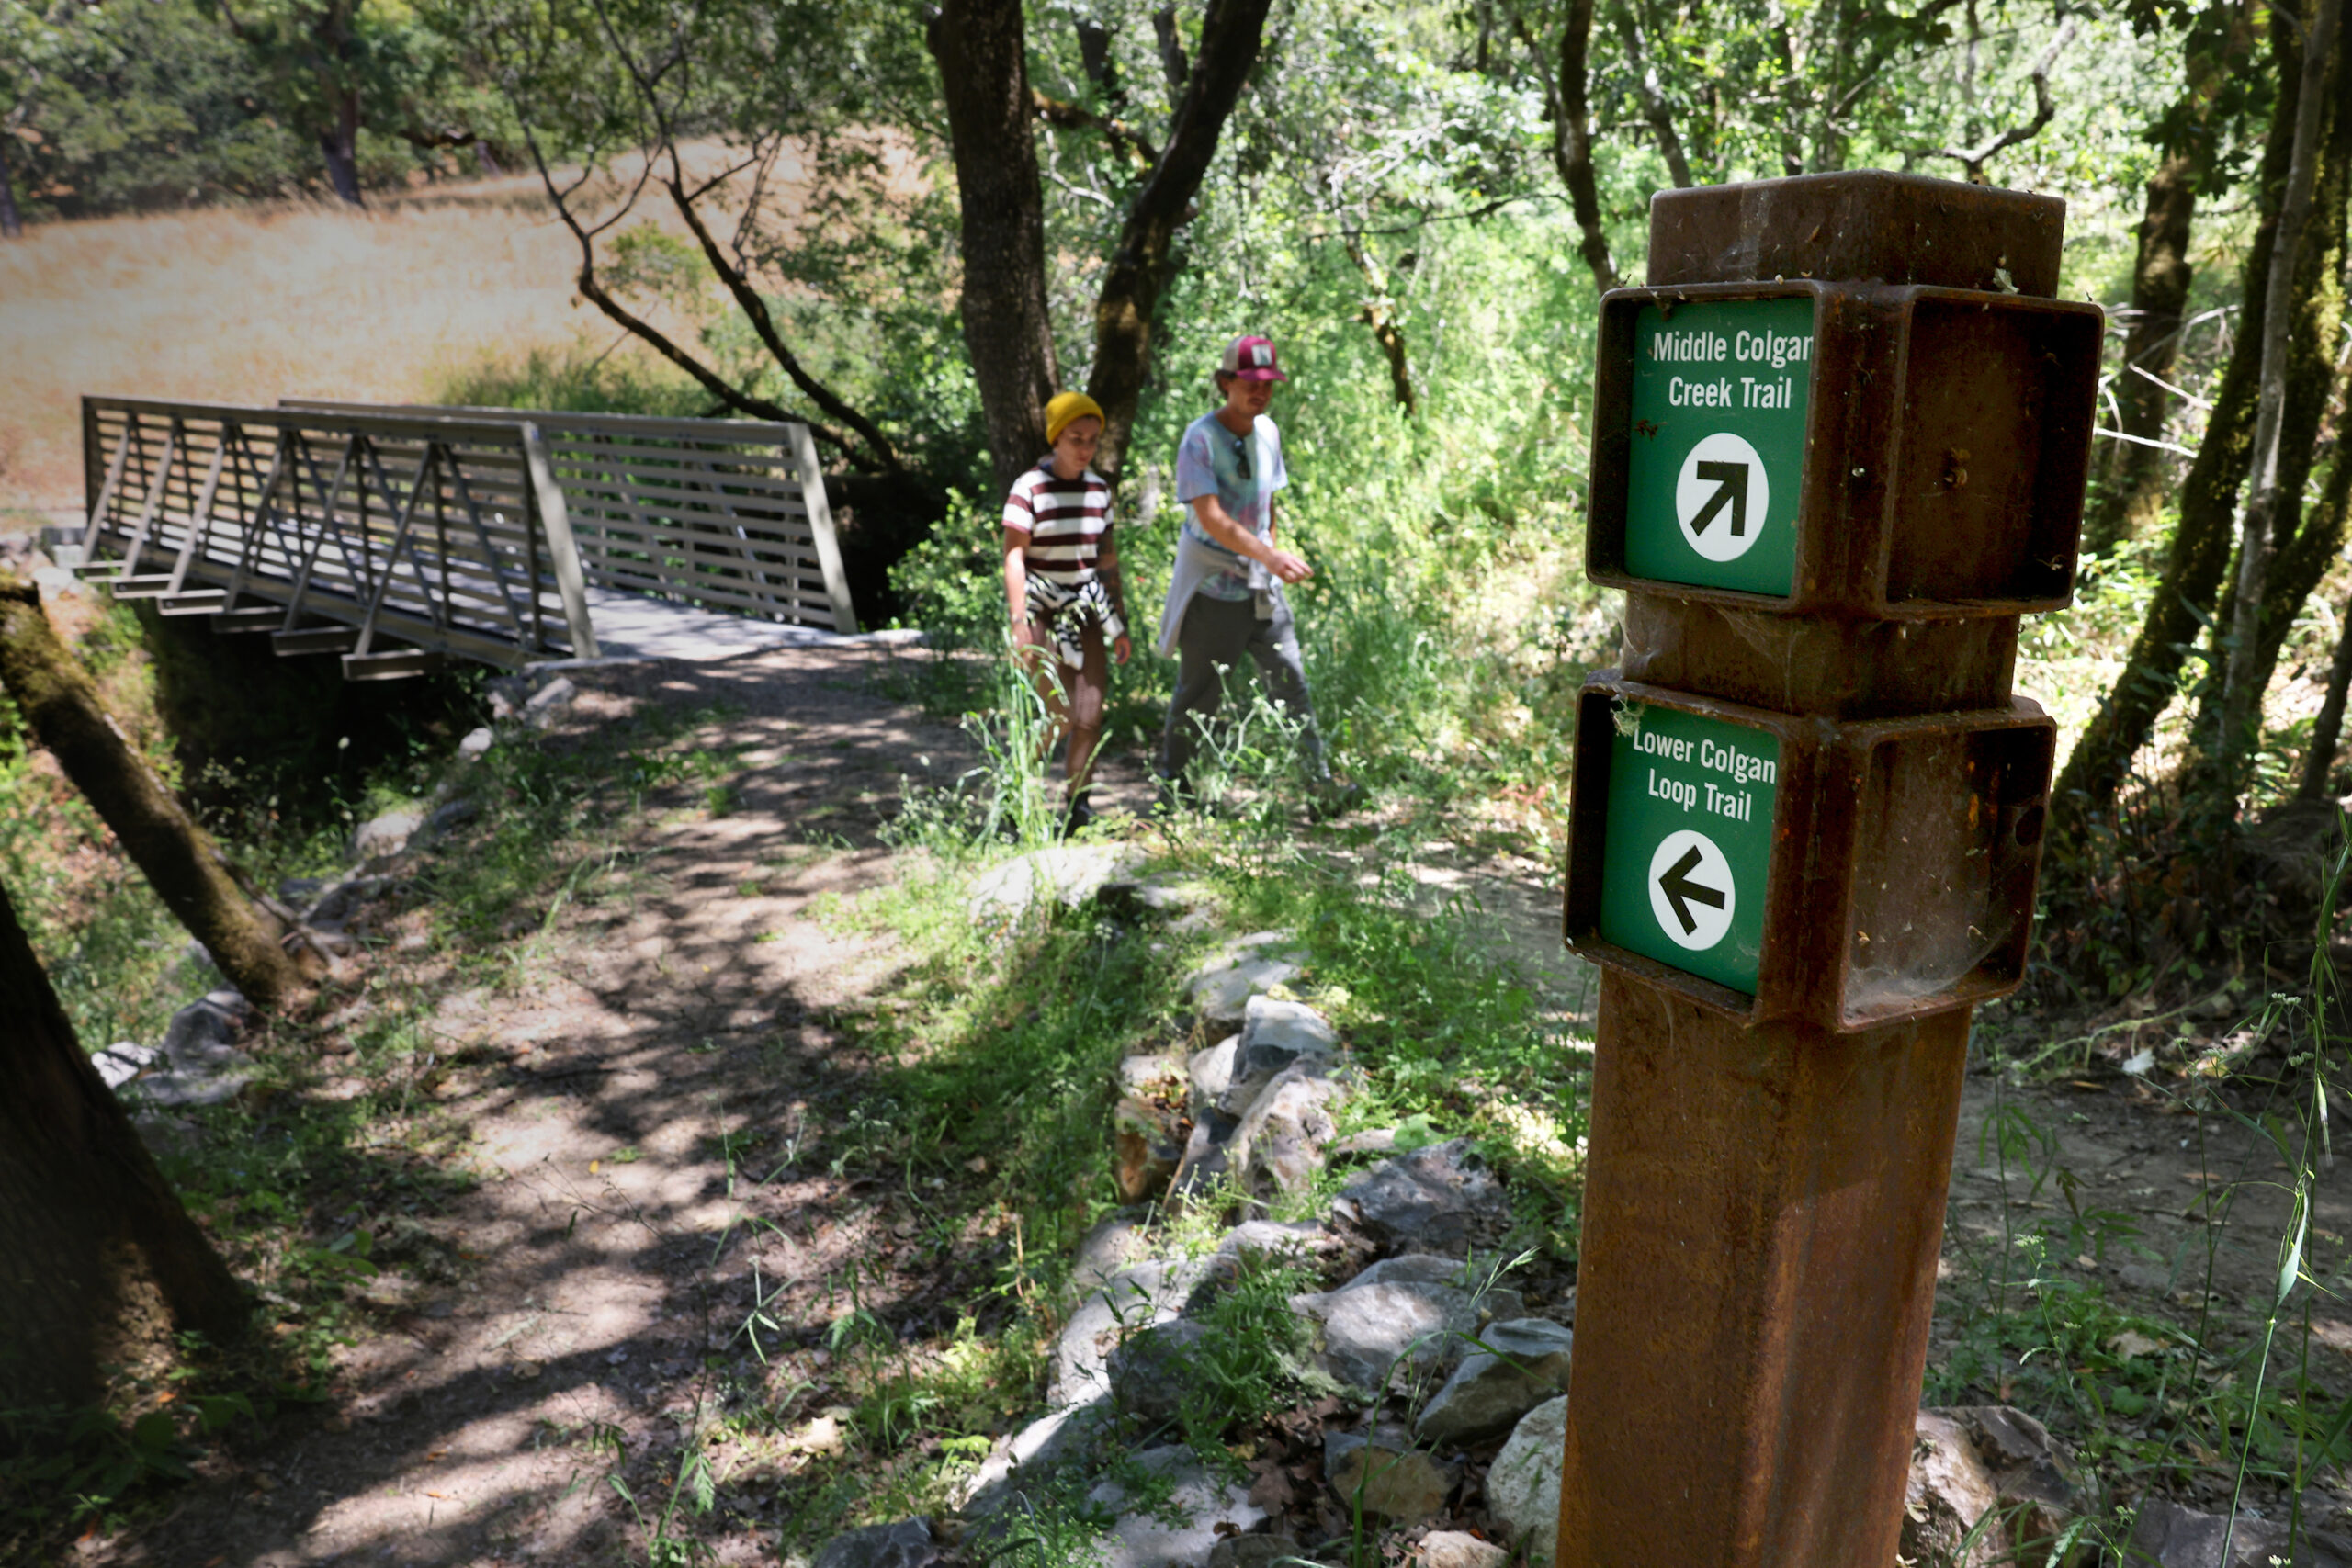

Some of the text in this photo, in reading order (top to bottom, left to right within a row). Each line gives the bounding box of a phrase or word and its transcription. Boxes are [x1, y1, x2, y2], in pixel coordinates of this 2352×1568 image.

[1654, 331, 1727, 361] Middle
[1669, 376, 1792, 408] Creek Trail
[1634, 728, 1777, 784] Lower Colgan
[1648, 768, 1752, 822] Loop Trail
